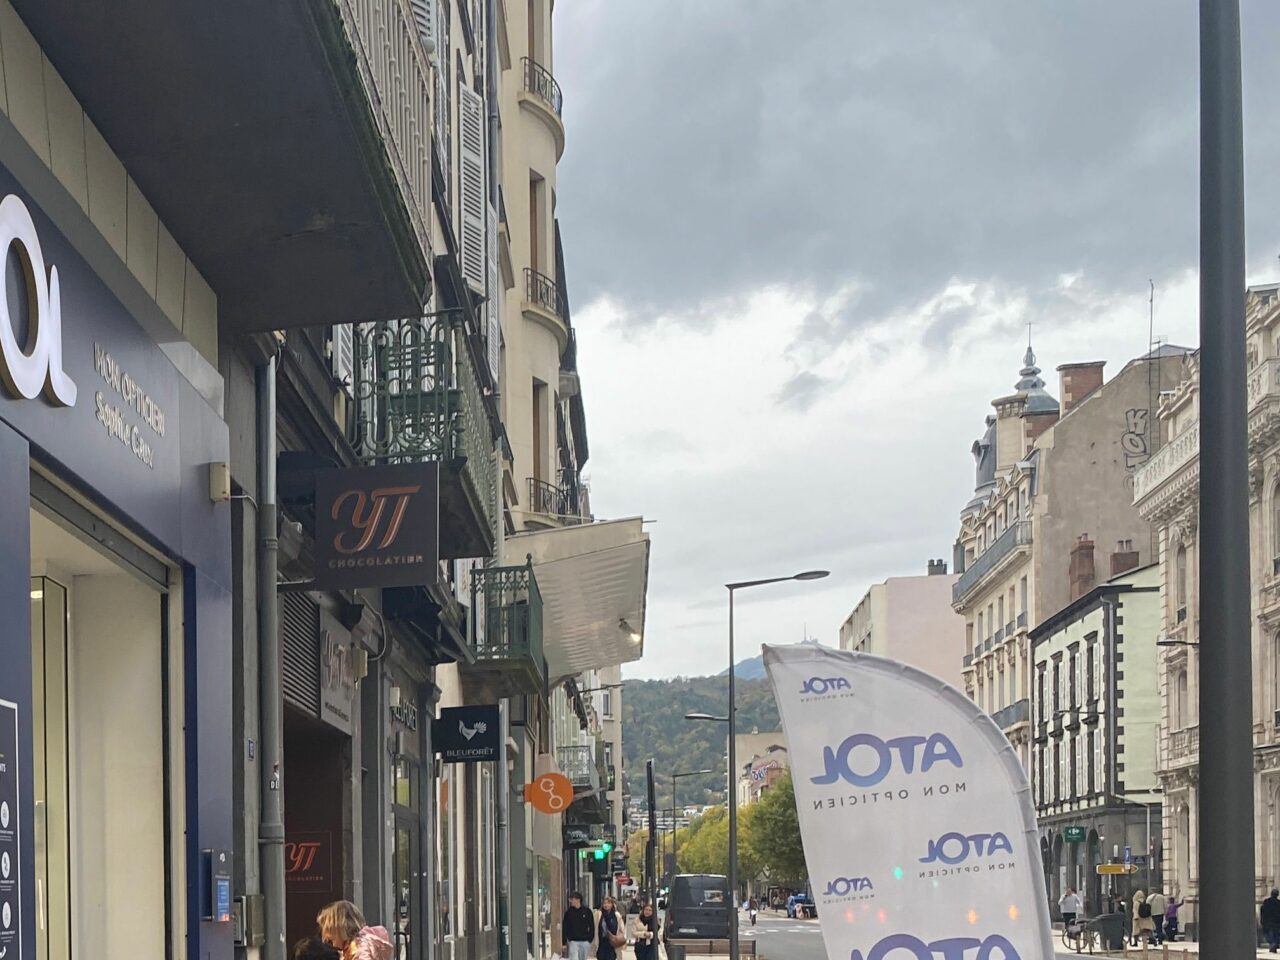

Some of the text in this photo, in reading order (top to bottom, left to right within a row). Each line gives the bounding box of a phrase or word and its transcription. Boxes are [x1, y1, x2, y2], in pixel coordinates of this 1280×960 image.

[94, 341, 165, 438] MON OPTICIEN
[95, 391, 131, 447] Sophie
[328, 555, 424, 569] CHOCOLATIER
[446, 746, 494, 757] BLEUFORÊT
